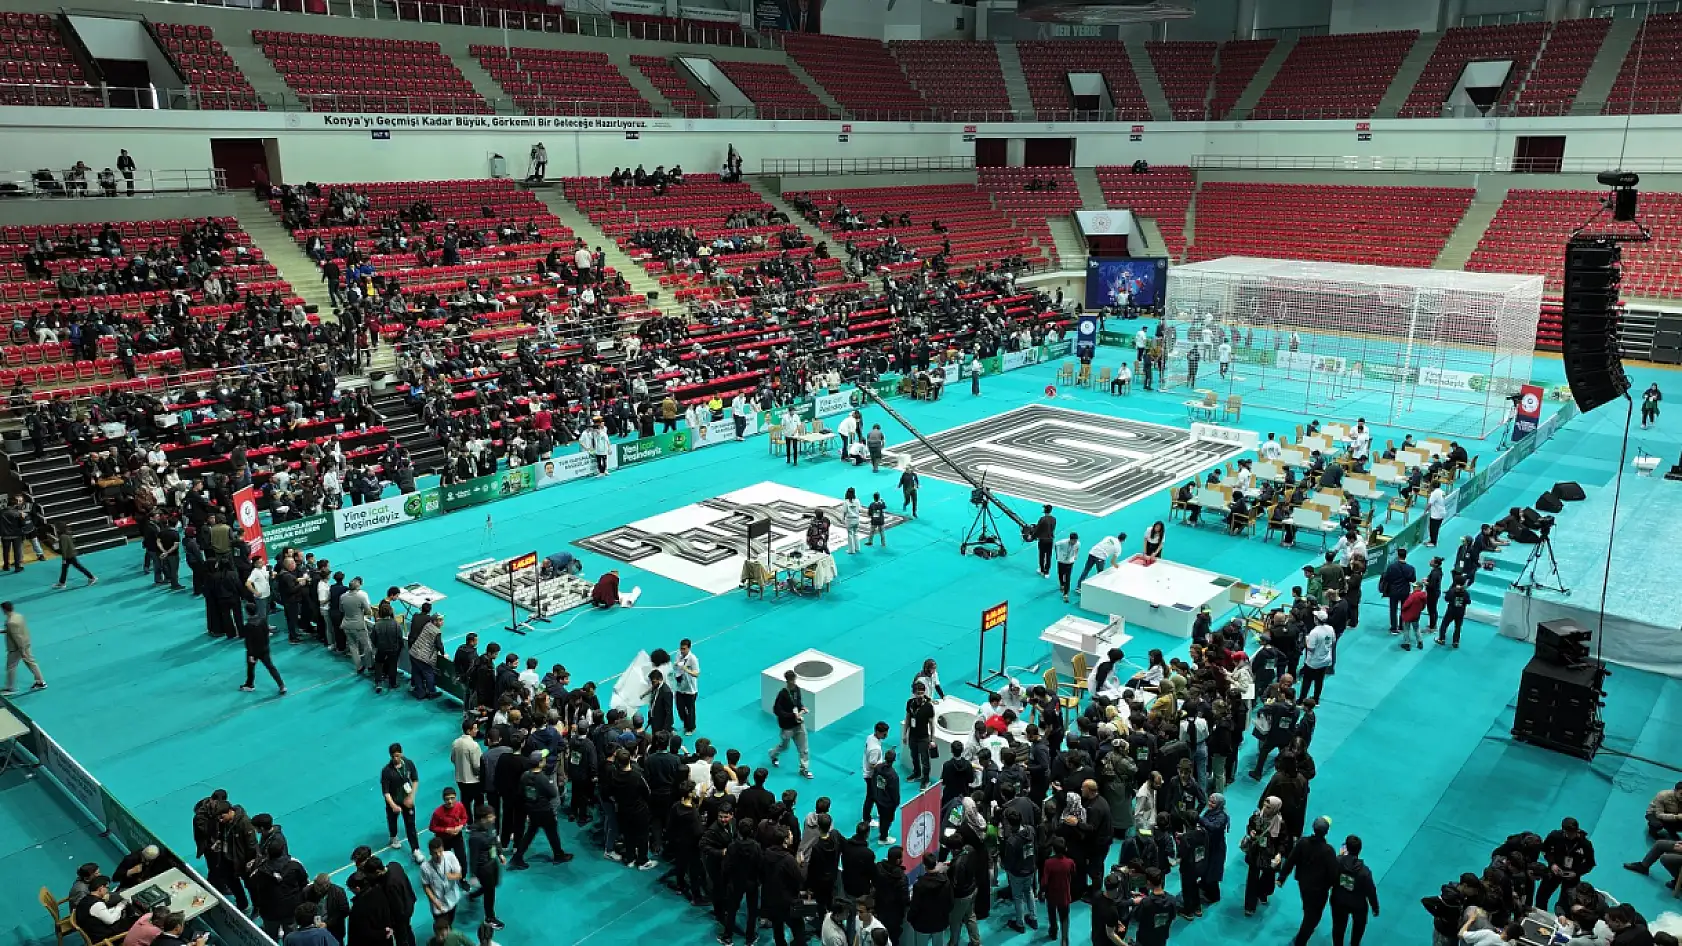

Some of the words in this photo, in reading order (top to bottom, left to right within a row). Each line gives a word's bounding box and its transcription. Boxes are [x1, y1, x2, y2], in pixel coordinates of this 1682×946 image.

[324, 115, 373, 127] Konya'yı
[377, 116, 419, 127] Geçmişi
[422, 116, 452, 126] Kadar
[456, 116, 490, 128] Büyük,
[492, 117, 536, 127] Görkemli
[538, 118, 551, 127] Bir
[554, 118, 593, 129] Geleceğe
[595, 119, 648, 129] Hazırlıyoruz.
[343, 510, 367, 521] Yine
[344, 511, 400, 531] Peşindeyiz
